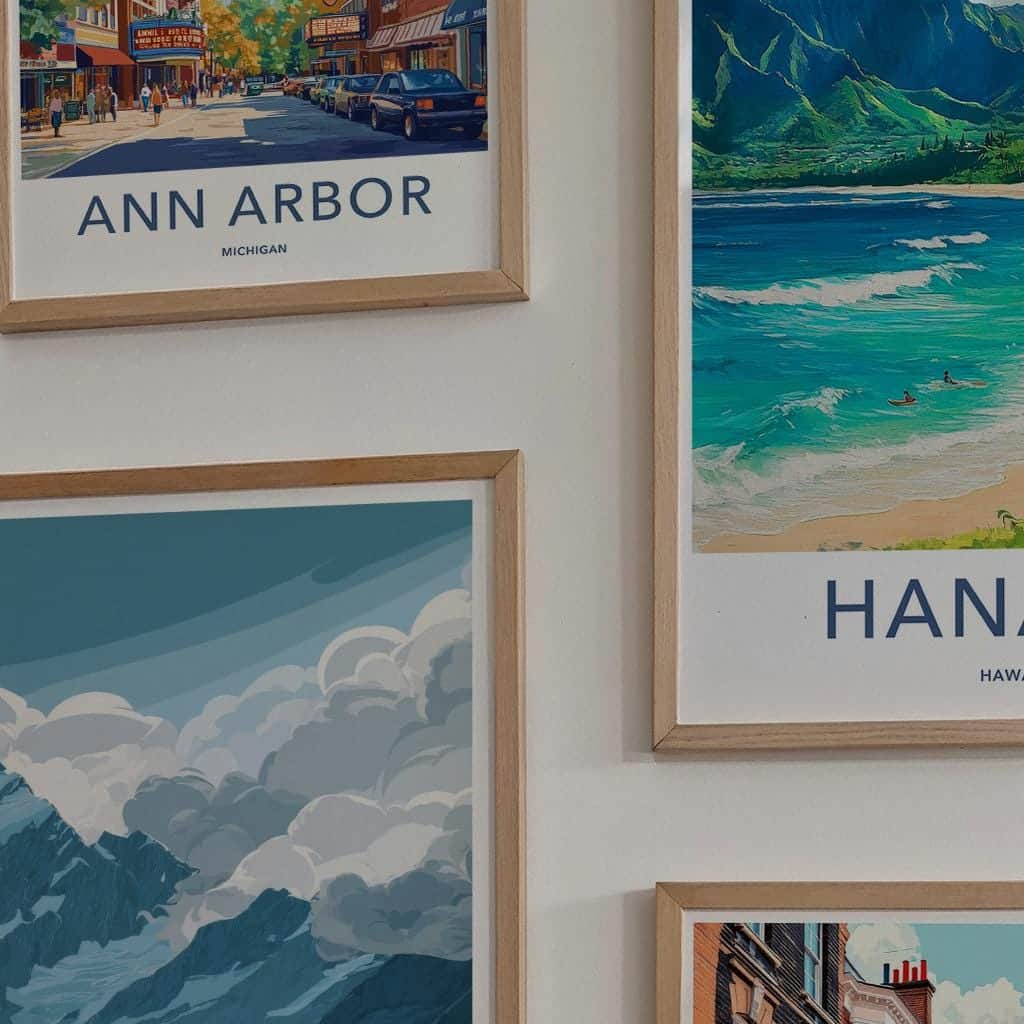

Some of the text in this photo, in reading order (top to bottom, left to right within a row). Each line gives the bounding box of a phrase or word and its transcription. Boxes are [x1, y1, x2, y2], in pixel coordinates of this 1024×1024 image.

[77, 175, 432, 236] ANN ARBOR
[221, 243, 288, 257] MICHIGAN
[827, 577, 1024, 639] HAN
[980, 668, 1024, 682] HAW
